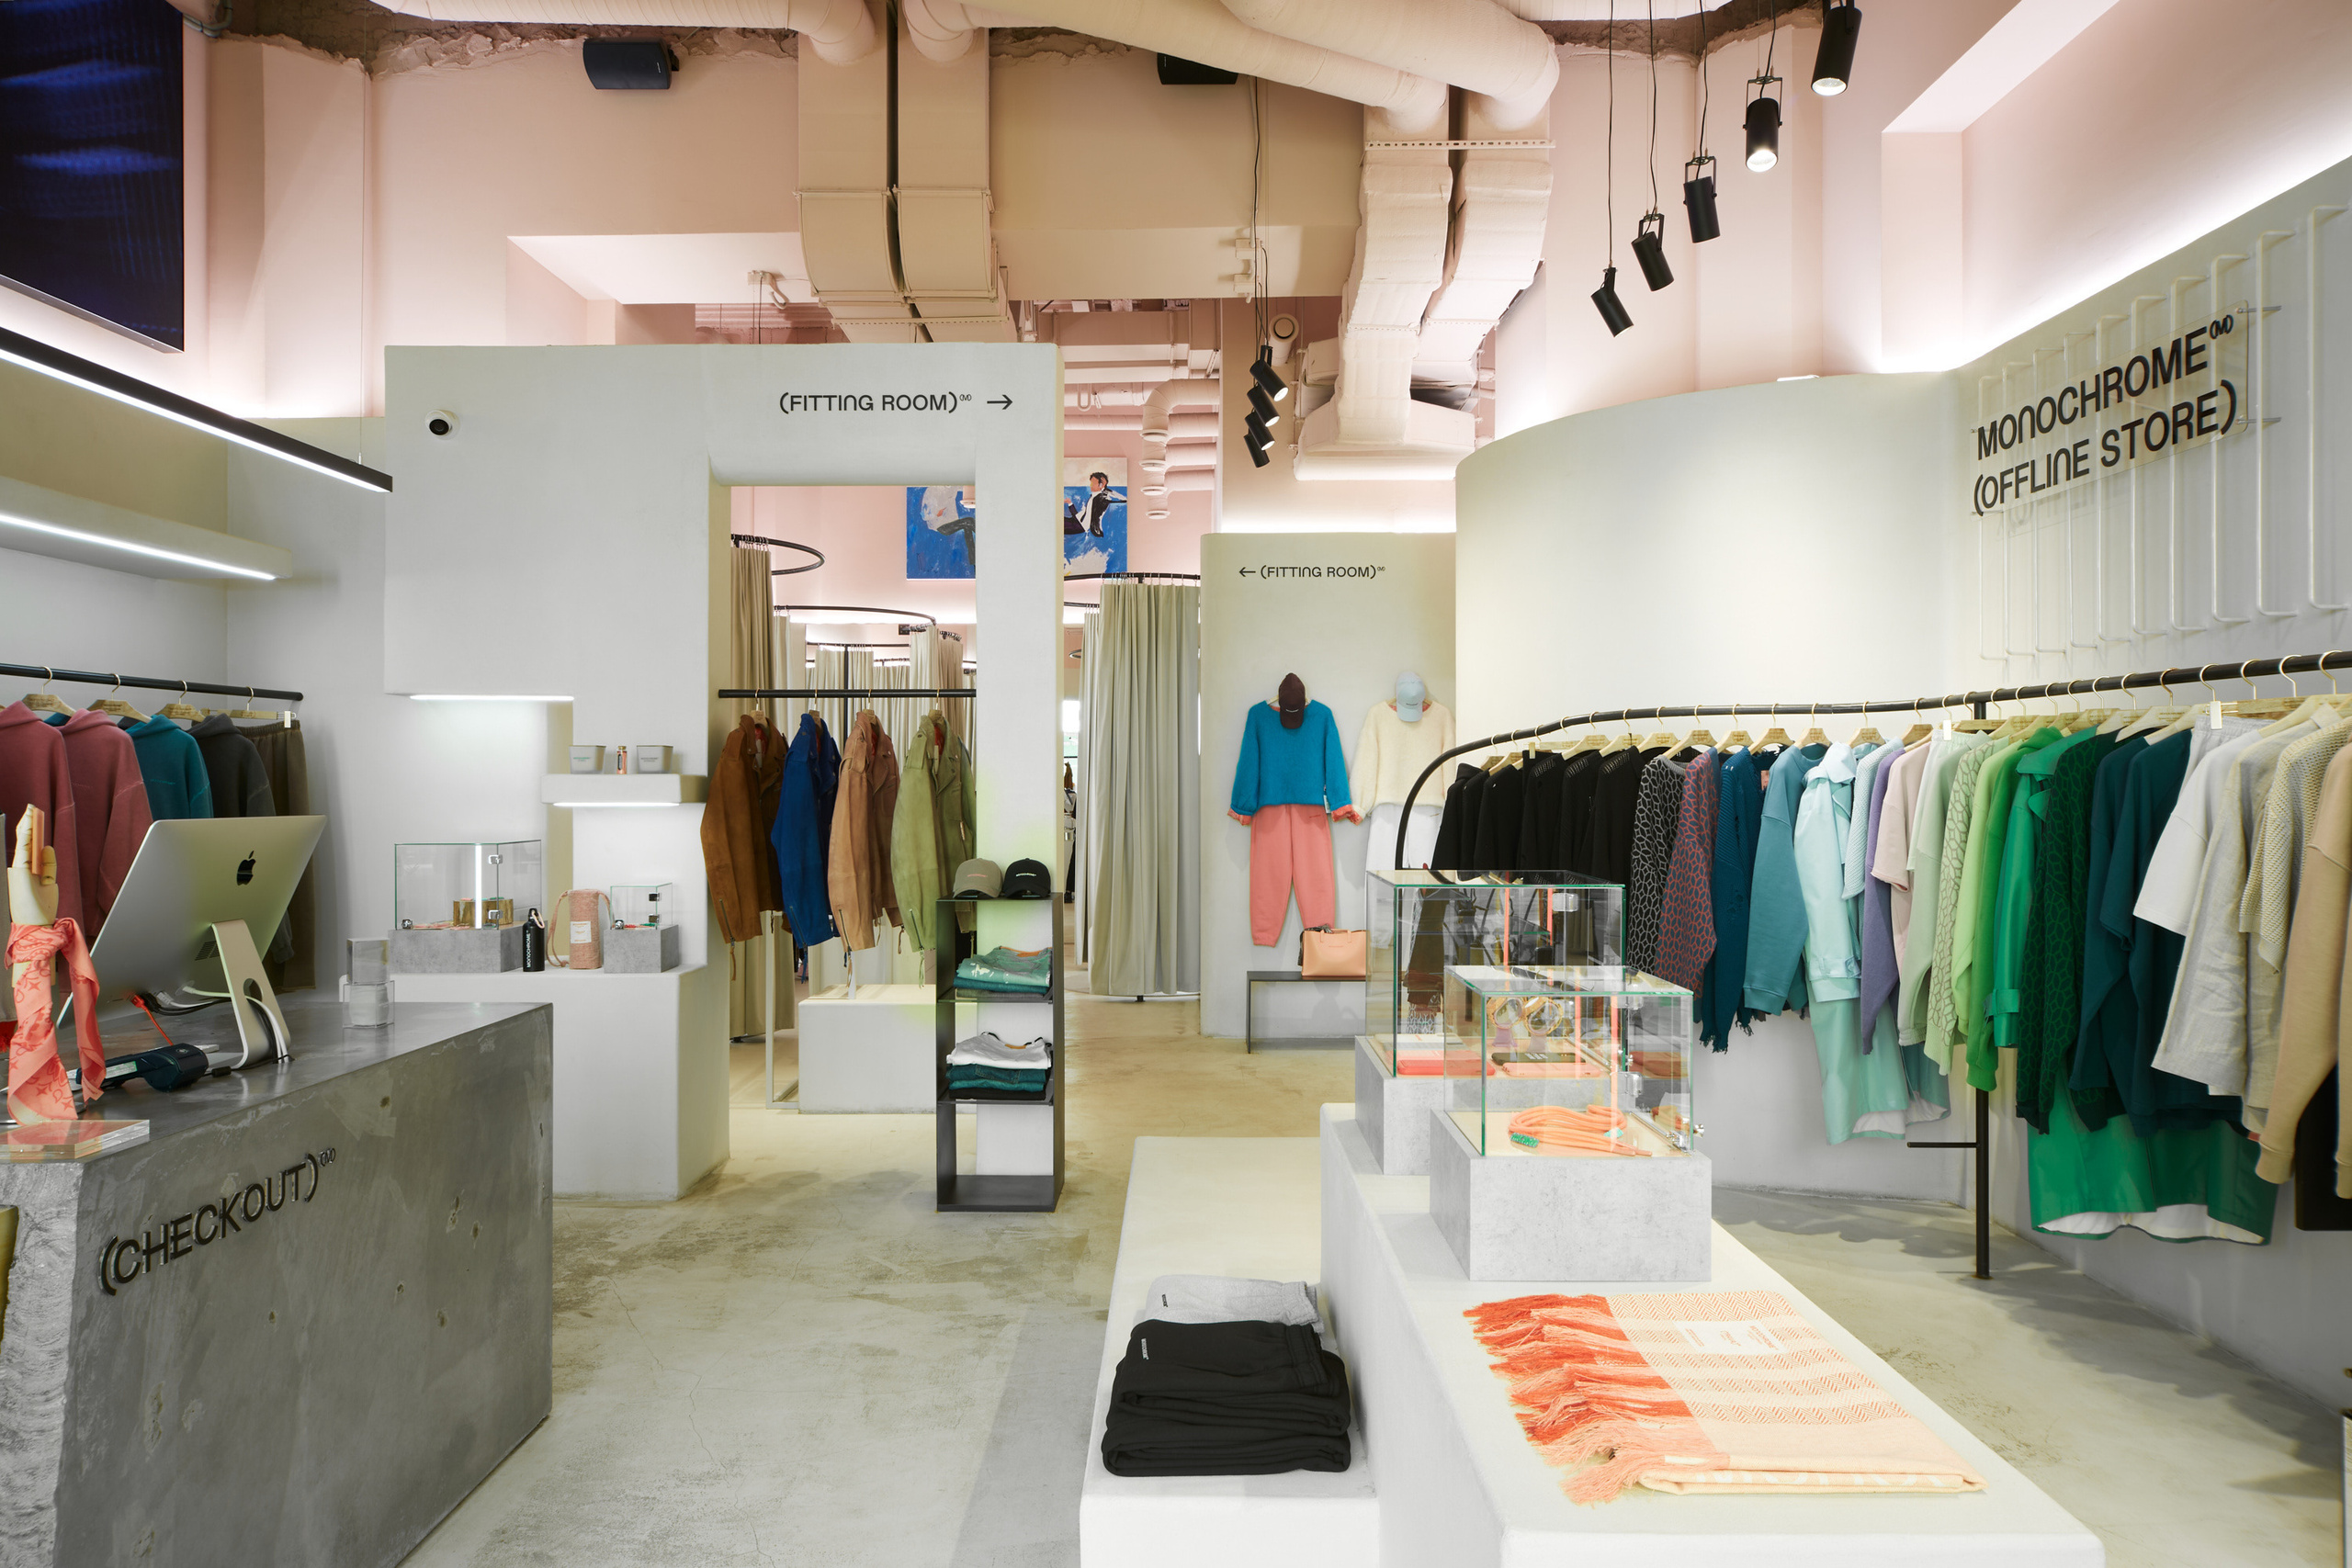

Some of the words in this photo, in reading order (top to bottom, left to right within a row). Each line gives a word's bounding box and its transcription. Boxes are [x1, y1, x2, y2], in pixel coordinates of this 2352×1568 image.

[780, 391, 874, 414] (FITTING
[1973, 438, 2090, 516] (OFFLINE
[2100, 378, 2237, 468] STORE)
[1978, 326, 2207, 460] MONOCHROME
